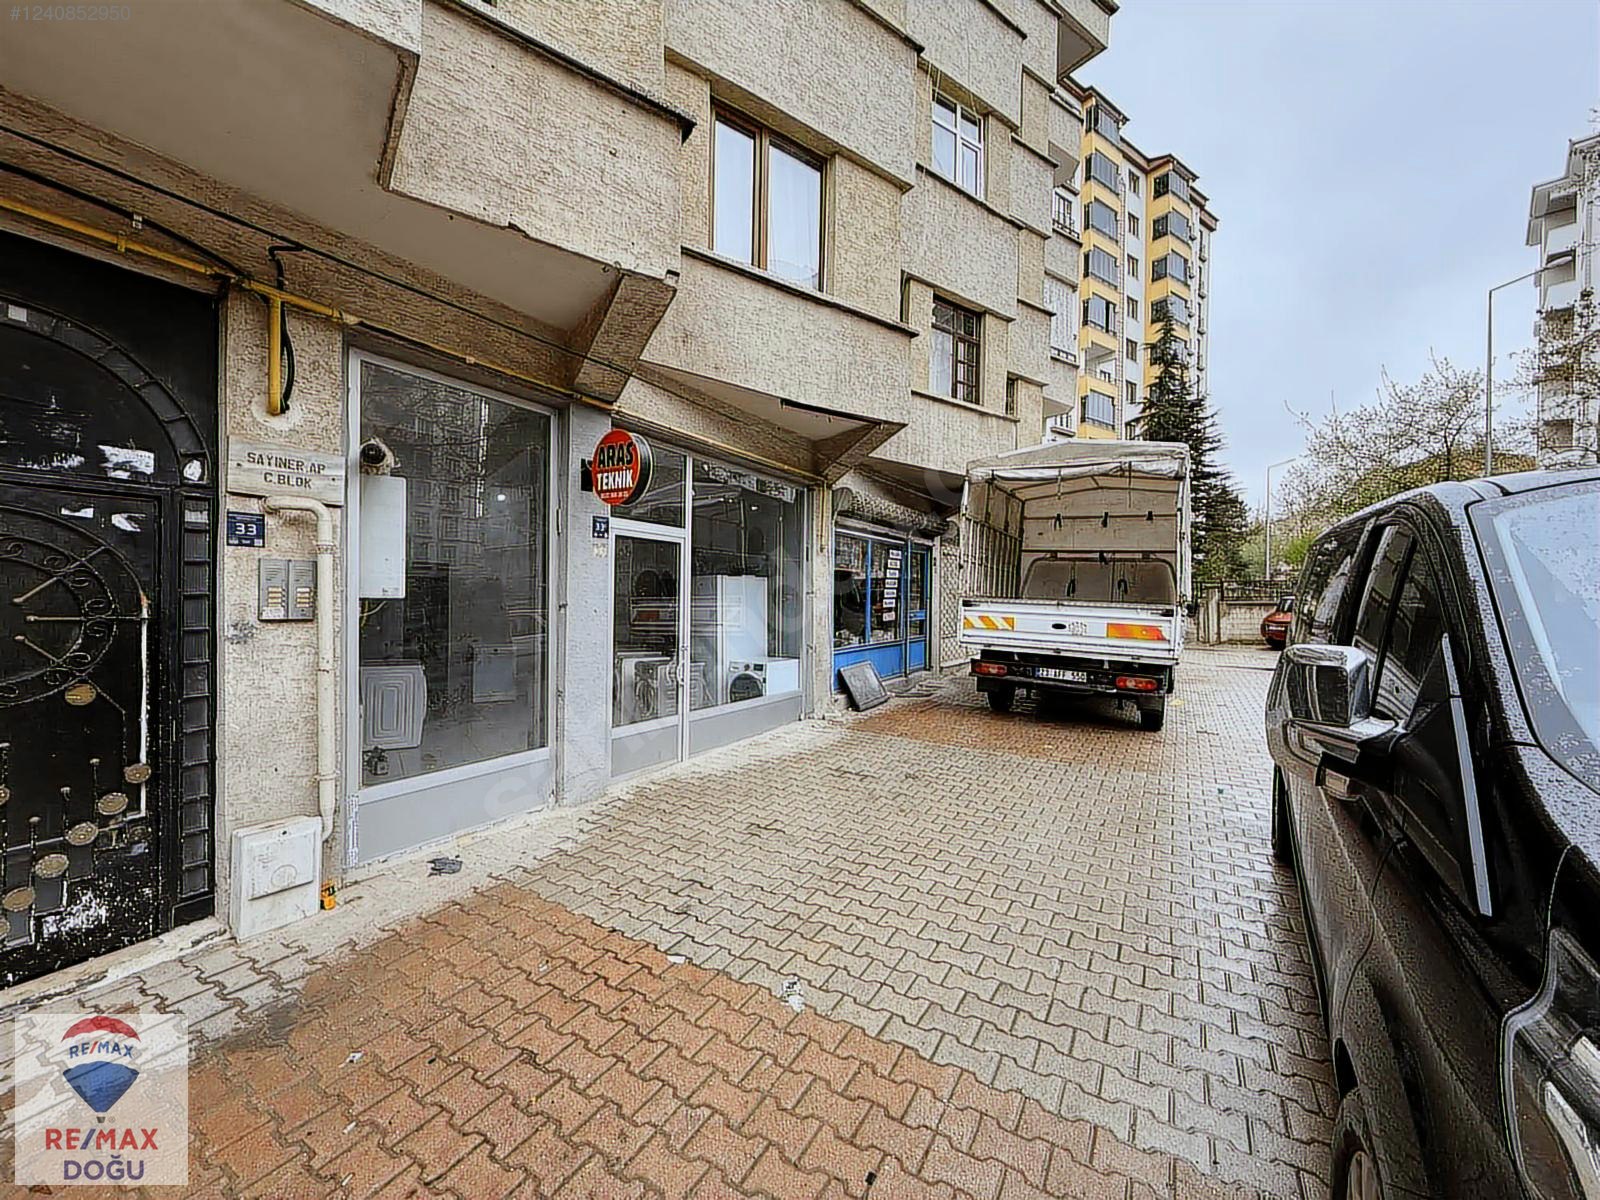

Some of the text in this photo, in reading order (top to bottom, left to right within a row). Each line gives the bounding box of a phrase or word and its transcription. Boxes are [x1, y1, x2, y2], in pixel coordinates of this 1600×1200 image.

[597, 441, 634, 468] ARAS
[597, 466, 633, 490] TEKNİK
[235, 523, 257, 535] 33
